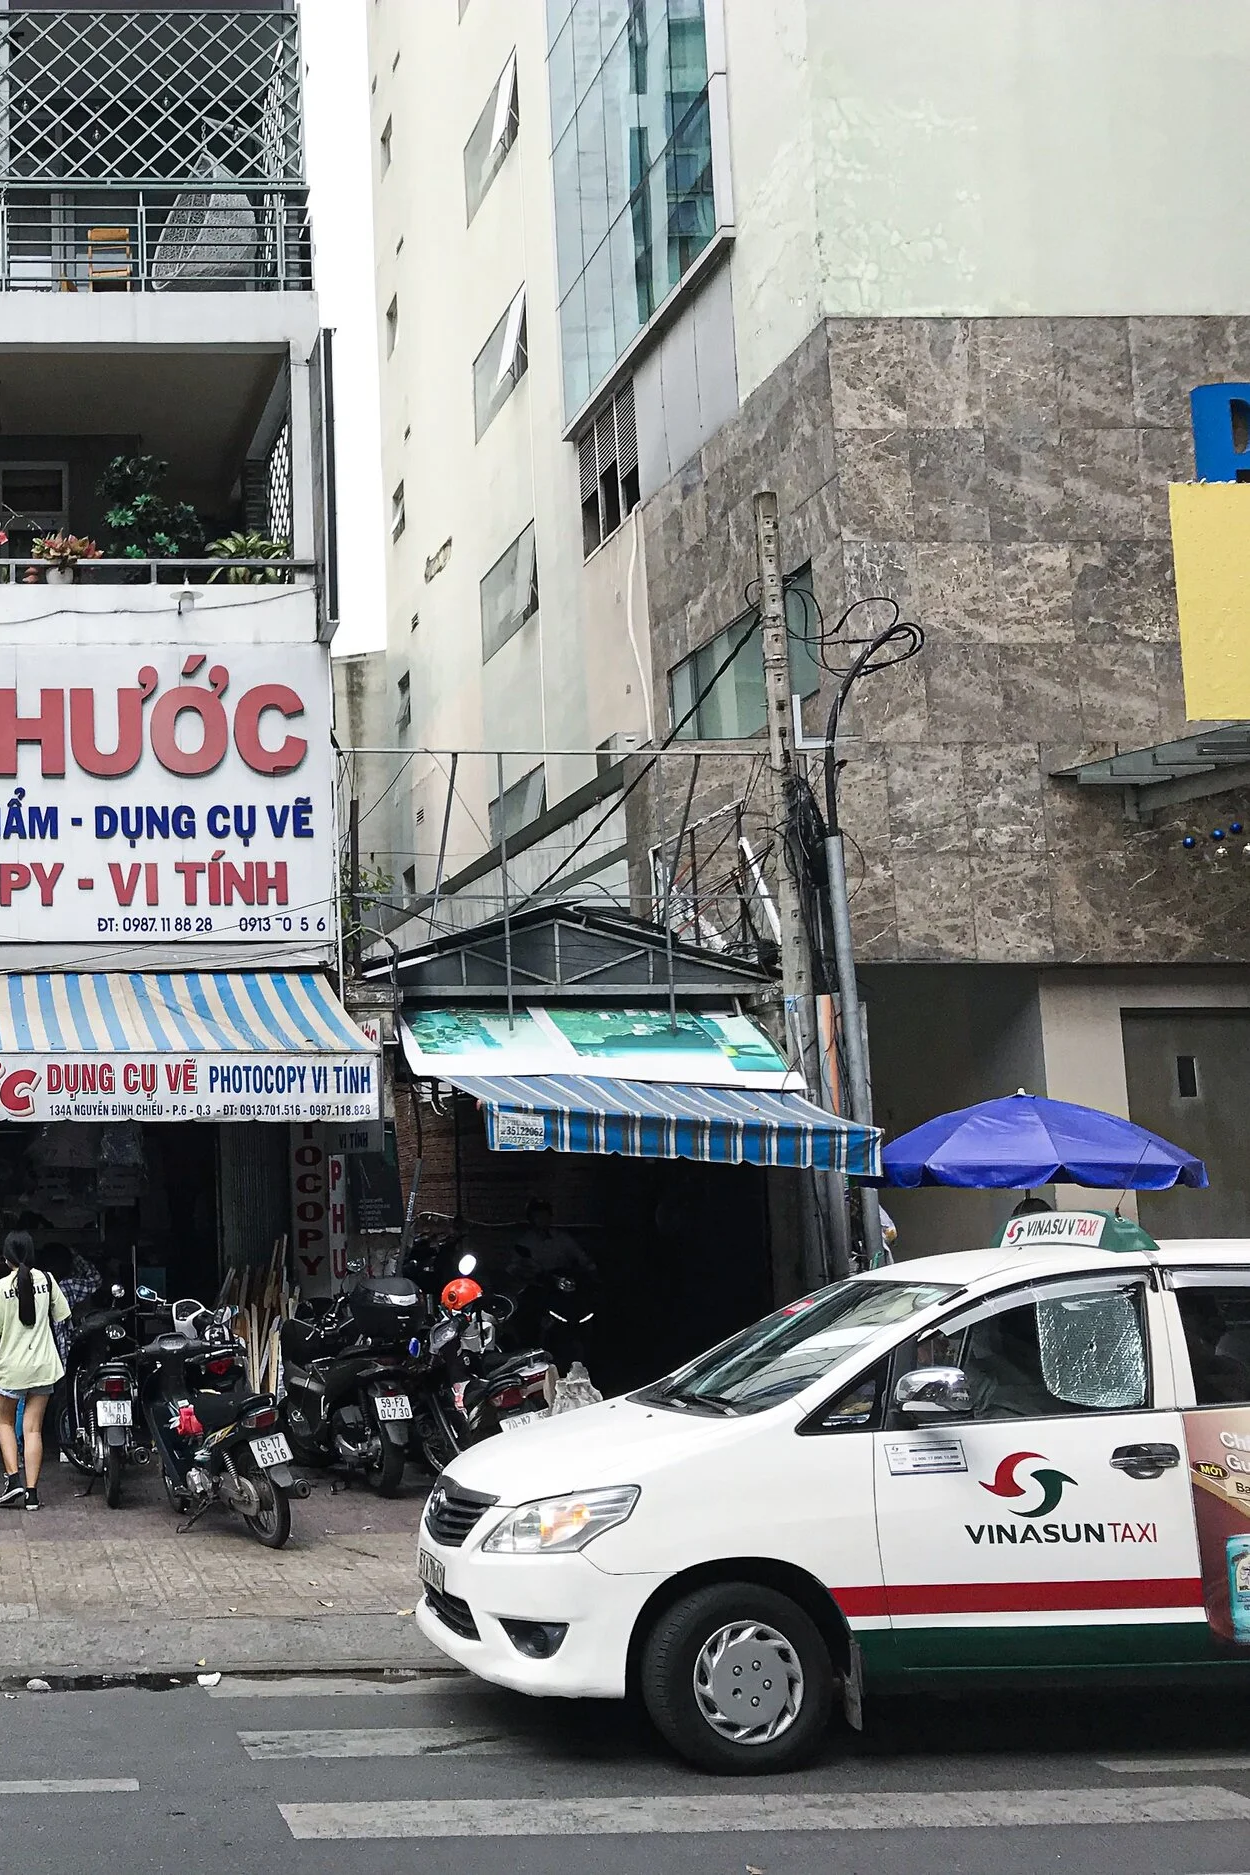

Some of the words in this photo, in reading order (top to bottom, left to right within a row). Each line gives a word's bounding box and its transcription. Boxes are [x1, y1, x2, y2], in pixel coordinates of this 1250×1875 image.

[94, 804, 196, 848] DỤNG
[207, 804, 257, 847] CỤ
[266, 796, 314, 839] VẼ
[108, 863, 159, 906] VI
[174, 850, 290, 906] TÍNH
[97, 917, 119, 932] ĐT:
[47, 1063, 116, 1101] DỤNG
[123, 1063, 157, 1101] CỤ
[165, 1058, 198, 1094] VẼ
[209, 1064, 306, 1094] PHOTOCOPY
[312, 1064, 328, 1094] VI
[335, 1060, 371, 1094] TÍNH
[49, 1104, 72, 1117] 134A
[111, 1102, 134, 1116] ĐÌNH
[172, 1105, 187, 1116] P.6
[223, 1104, 238, 1116] ĐT:
[240, 1104, 301, 1117] 0913.701.516
[309, 1103, 371, 1117] 0987.118.828
[261, 1450, 288, 1465] 6916
[964, 1523, 1106, 1545] VINASUN
[1107, 1522, 1159, 1543] TAXI
